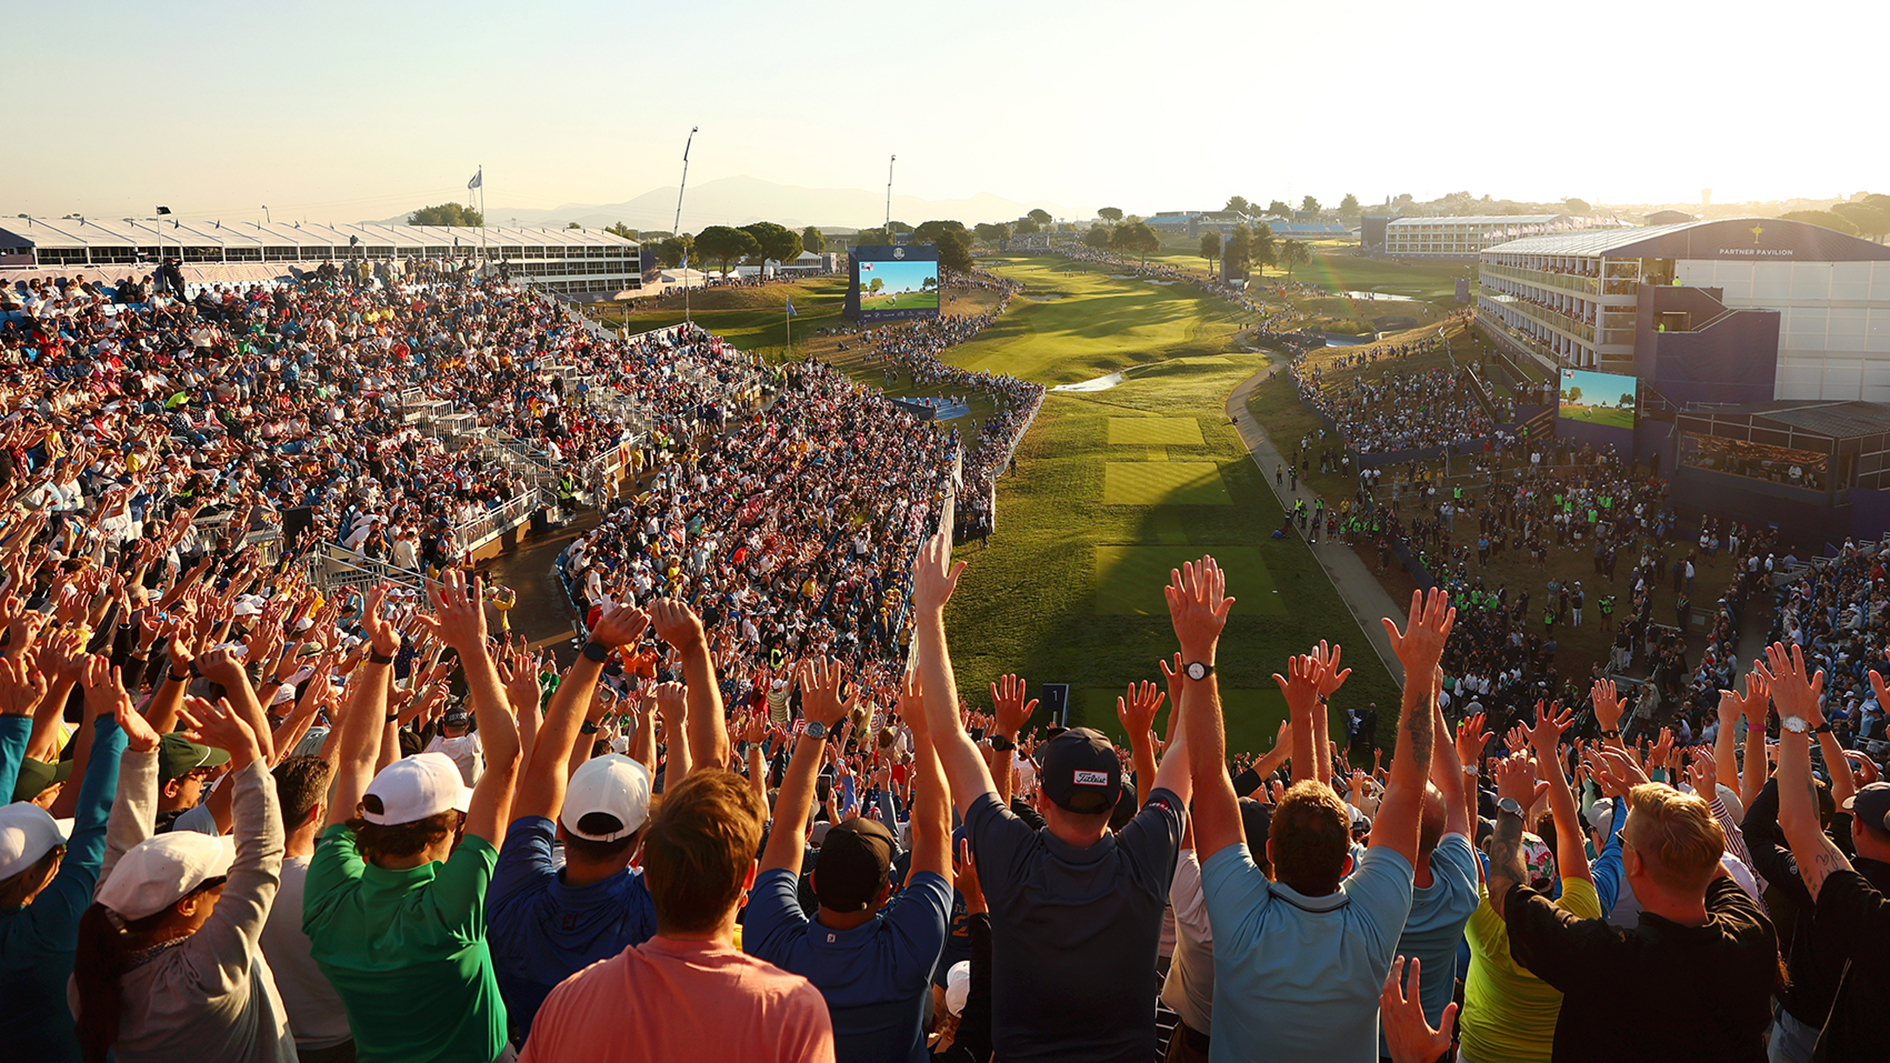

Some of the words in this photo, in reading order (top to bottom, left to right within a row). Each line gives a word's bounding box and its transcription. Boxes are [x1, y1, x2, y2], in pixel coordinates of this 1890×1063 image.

[1719, 248, 1755, 256] PARTNER
[1052, 690, 1058, 702] 1
[1075, 772, 1107, 785] Titleist
